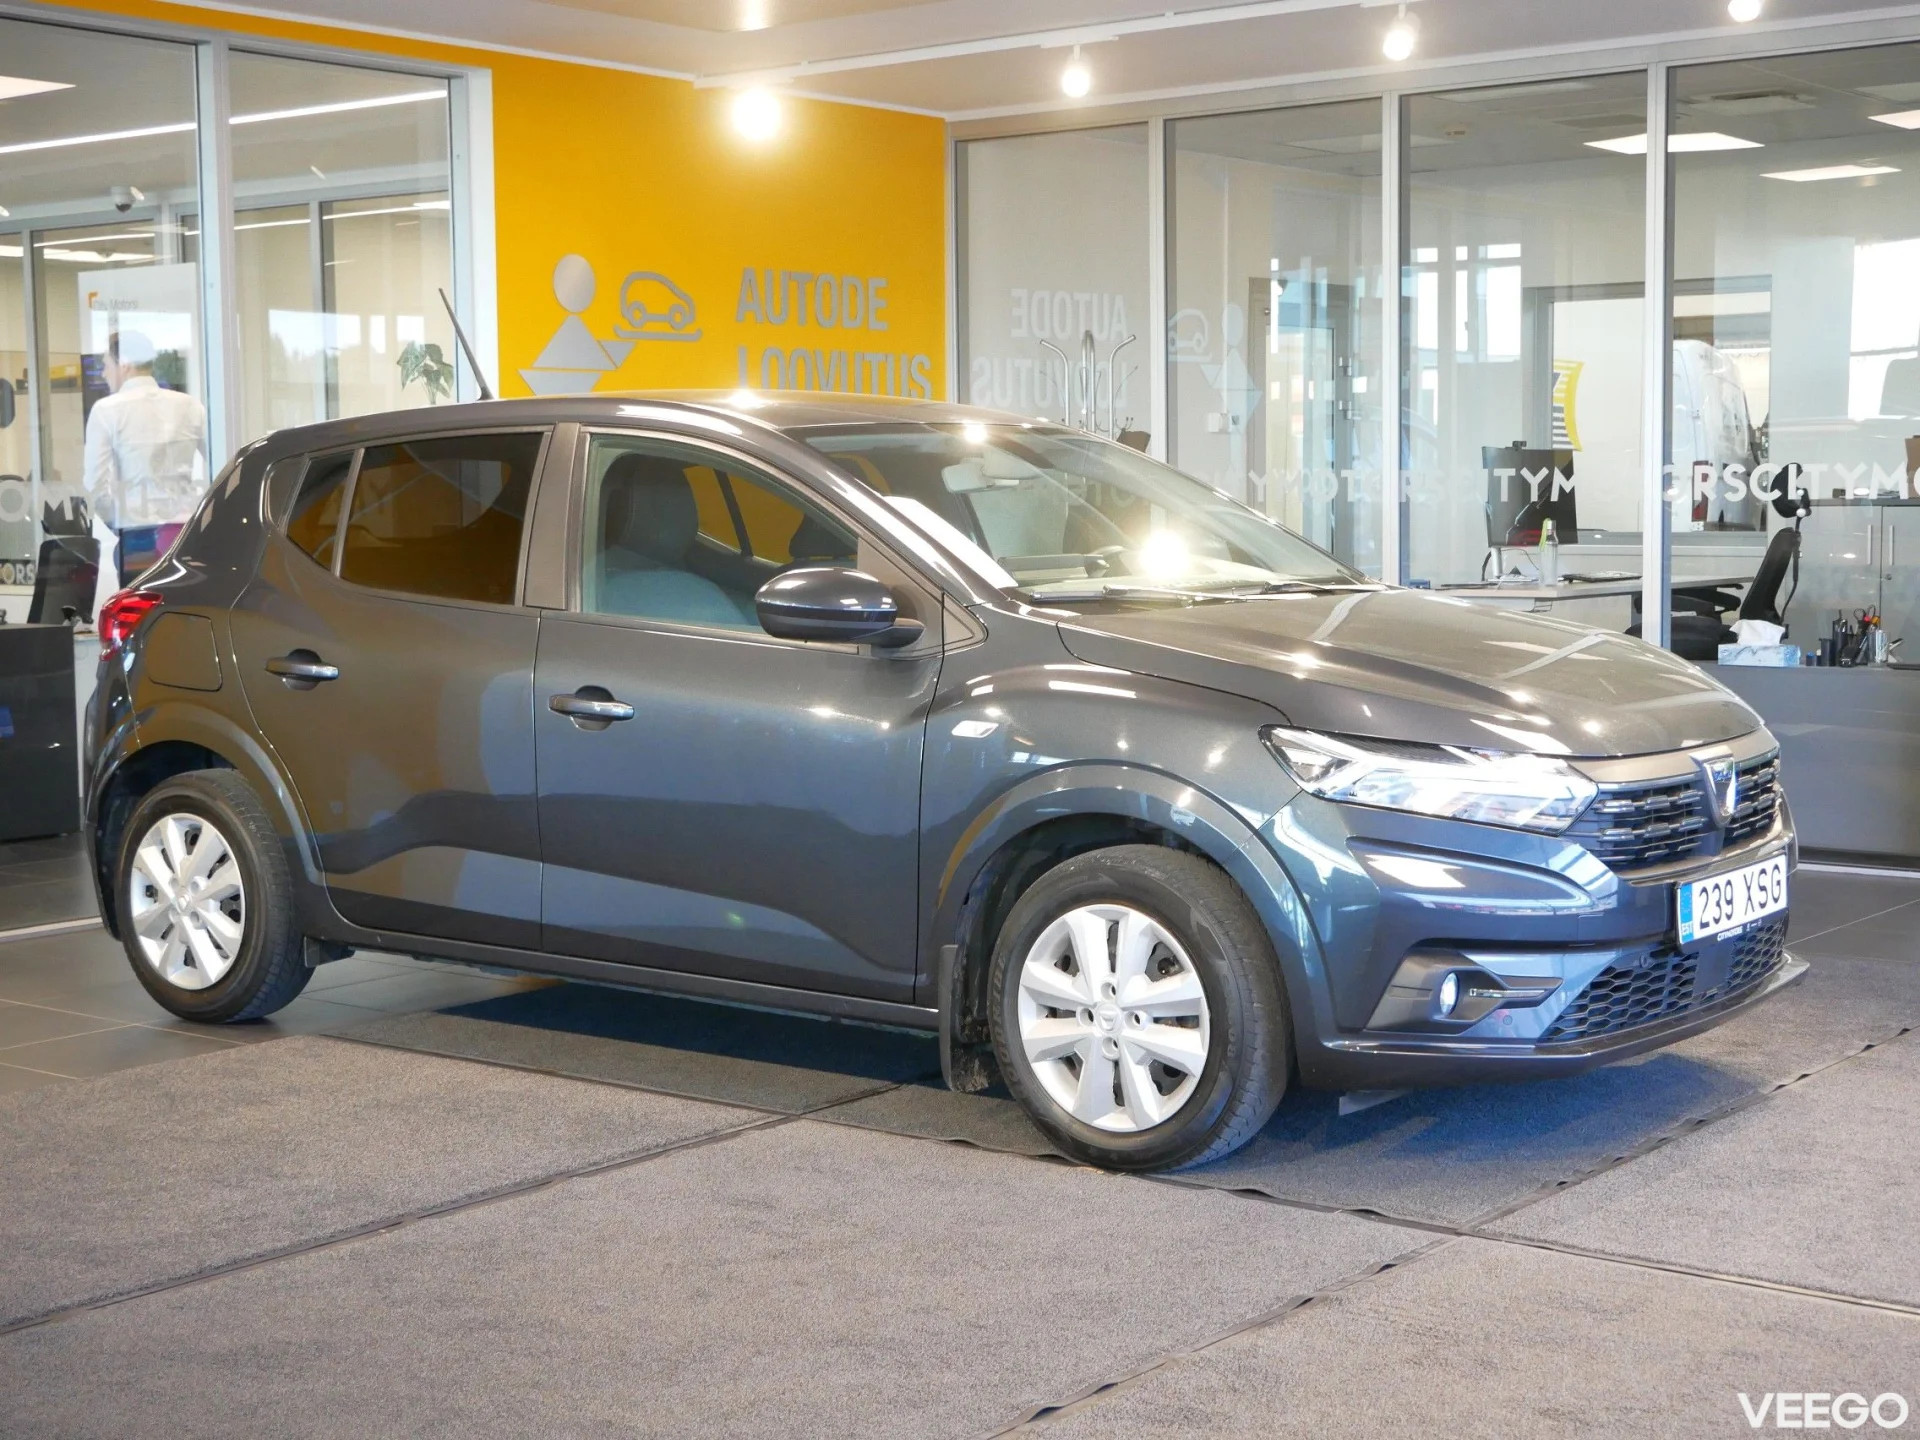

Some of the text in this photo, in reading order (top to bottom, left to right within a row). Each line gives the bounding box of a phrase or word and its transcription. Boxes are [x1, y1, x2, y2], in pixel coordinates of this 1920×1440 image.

[735, 266, 889, 331] AUTODE
[0, 562, 36, 585] ORS
[1699, 863, 1781, 930] 239 XSG
